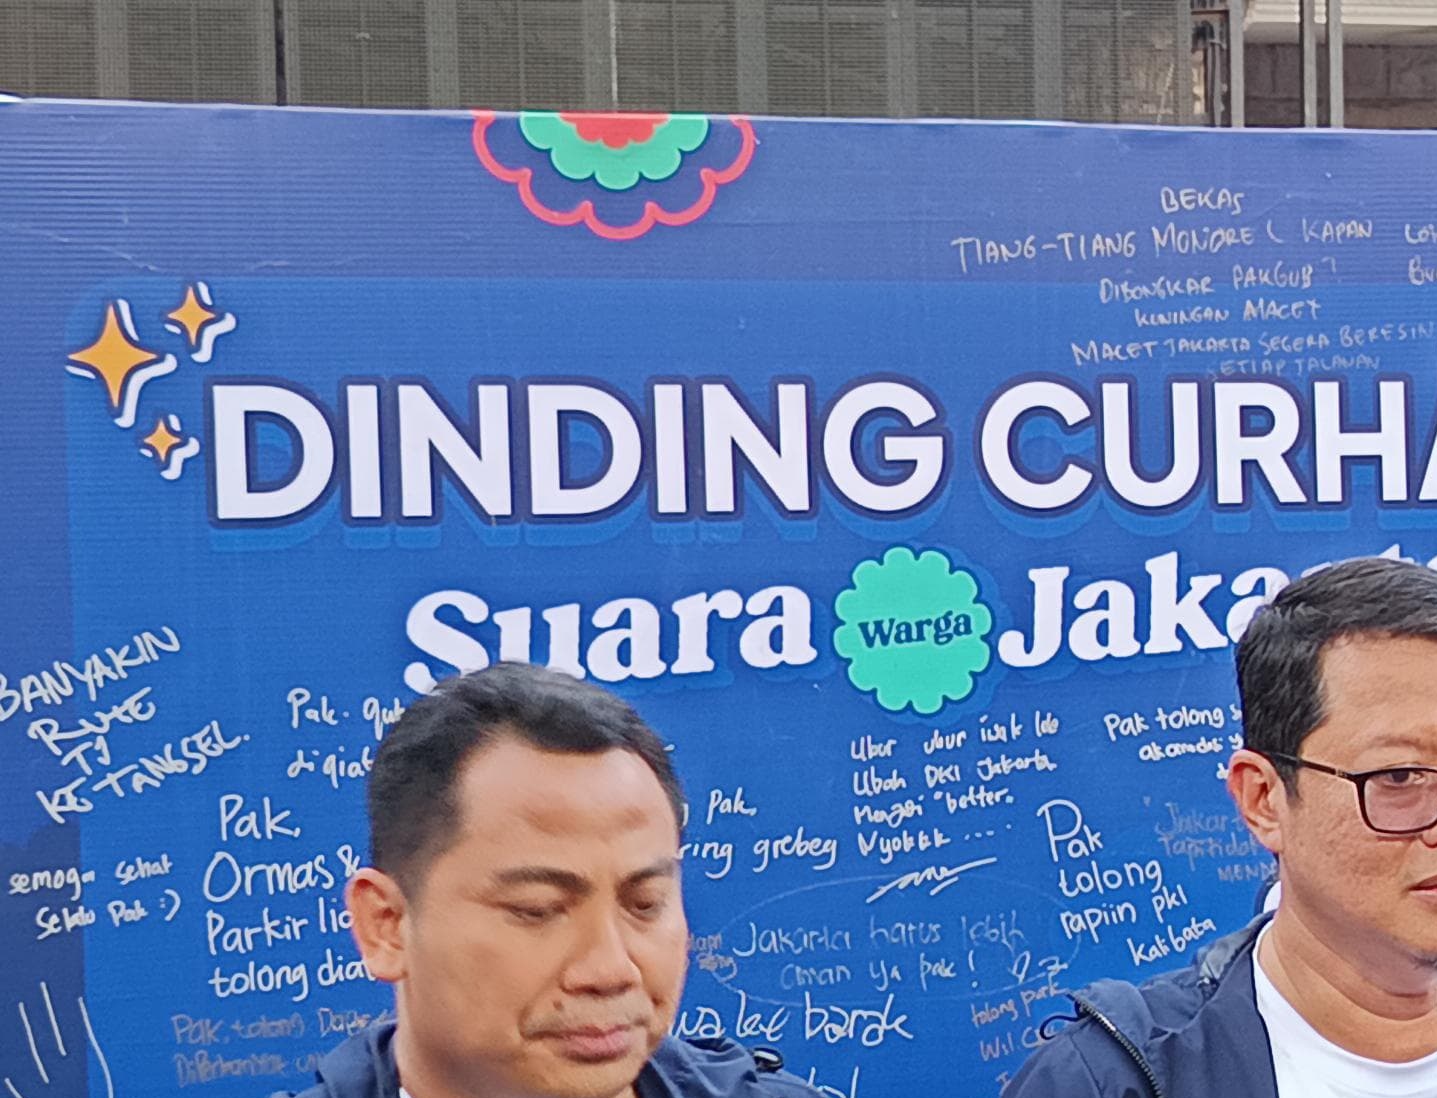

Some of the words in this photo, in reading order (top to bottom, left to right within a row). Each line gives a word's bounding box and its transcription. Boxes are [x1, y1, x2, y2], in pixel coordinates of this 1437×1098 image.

[1160, 186, 1245, 215] BEKAS
[1302, 218, 1374, 243] KAPAN
[1242, 297, 1322, 322] MACET
[1069, 340, 1155, 369] MACET
[211, 380, 945, 520] DINDING
[402, 583, 819, 697] Suara
[856, 606, 975, 652] Warga
[1155, 705, 1225, 731] tolong
[1036, 798, 1104, 862] Pak
[202, 851, 336, 903] Ormas
[1058, 860, 1163, 898] tolong
[205, 906, 311, 956] Parkir
[208, 960, 310, 1003] tolong
